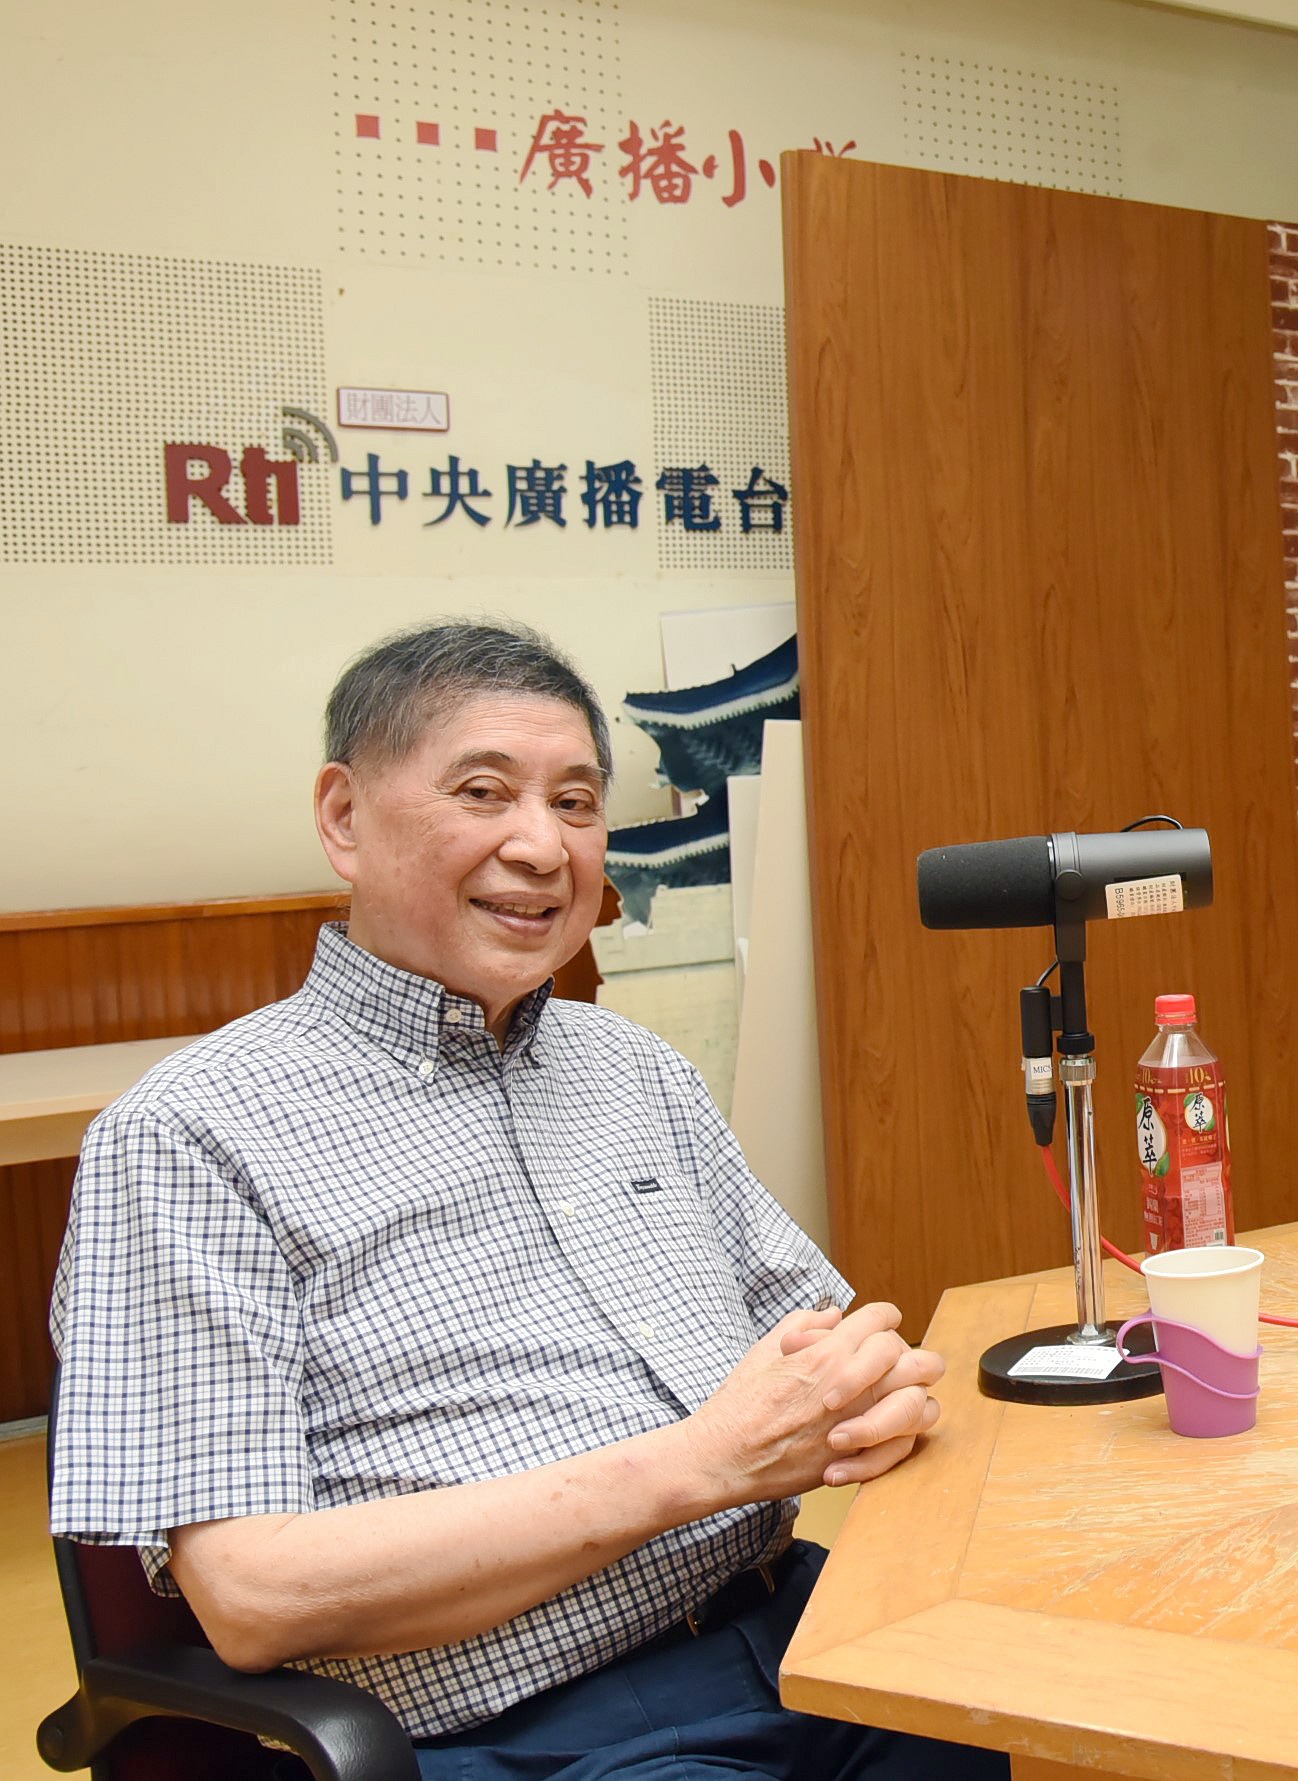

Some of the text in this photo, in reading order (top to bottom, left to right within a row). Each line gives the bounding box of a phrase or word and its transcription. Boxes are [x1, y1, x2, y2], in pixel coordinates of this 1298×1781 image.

[519, 108, 857, 208] 廣播小
[347, 391, 441, 425] 財團法人
[339, 452, 789, 534] 中央廣播電台
